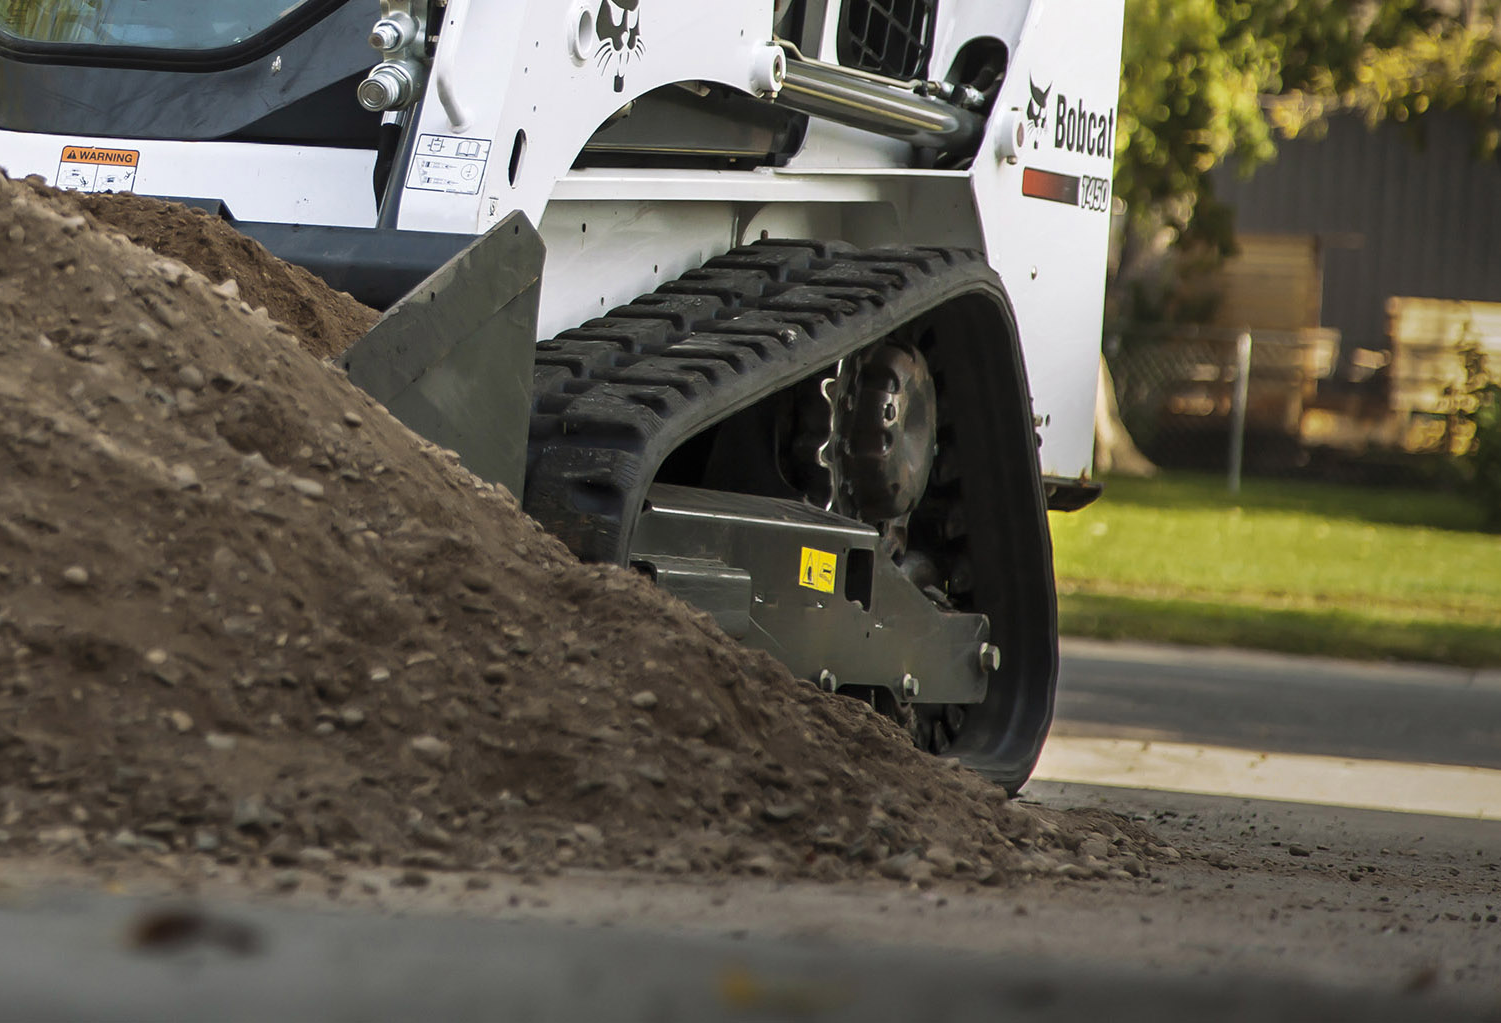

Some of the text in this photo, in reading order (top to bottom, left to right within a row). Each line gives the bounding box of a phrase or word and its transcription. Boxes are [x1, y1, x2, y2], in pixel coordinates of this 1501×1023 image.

[1054, 93, 1114, 160] Bobcat
[79, 150, 133, 163] WARNING
[1080, 175, 1110, 212] T450
